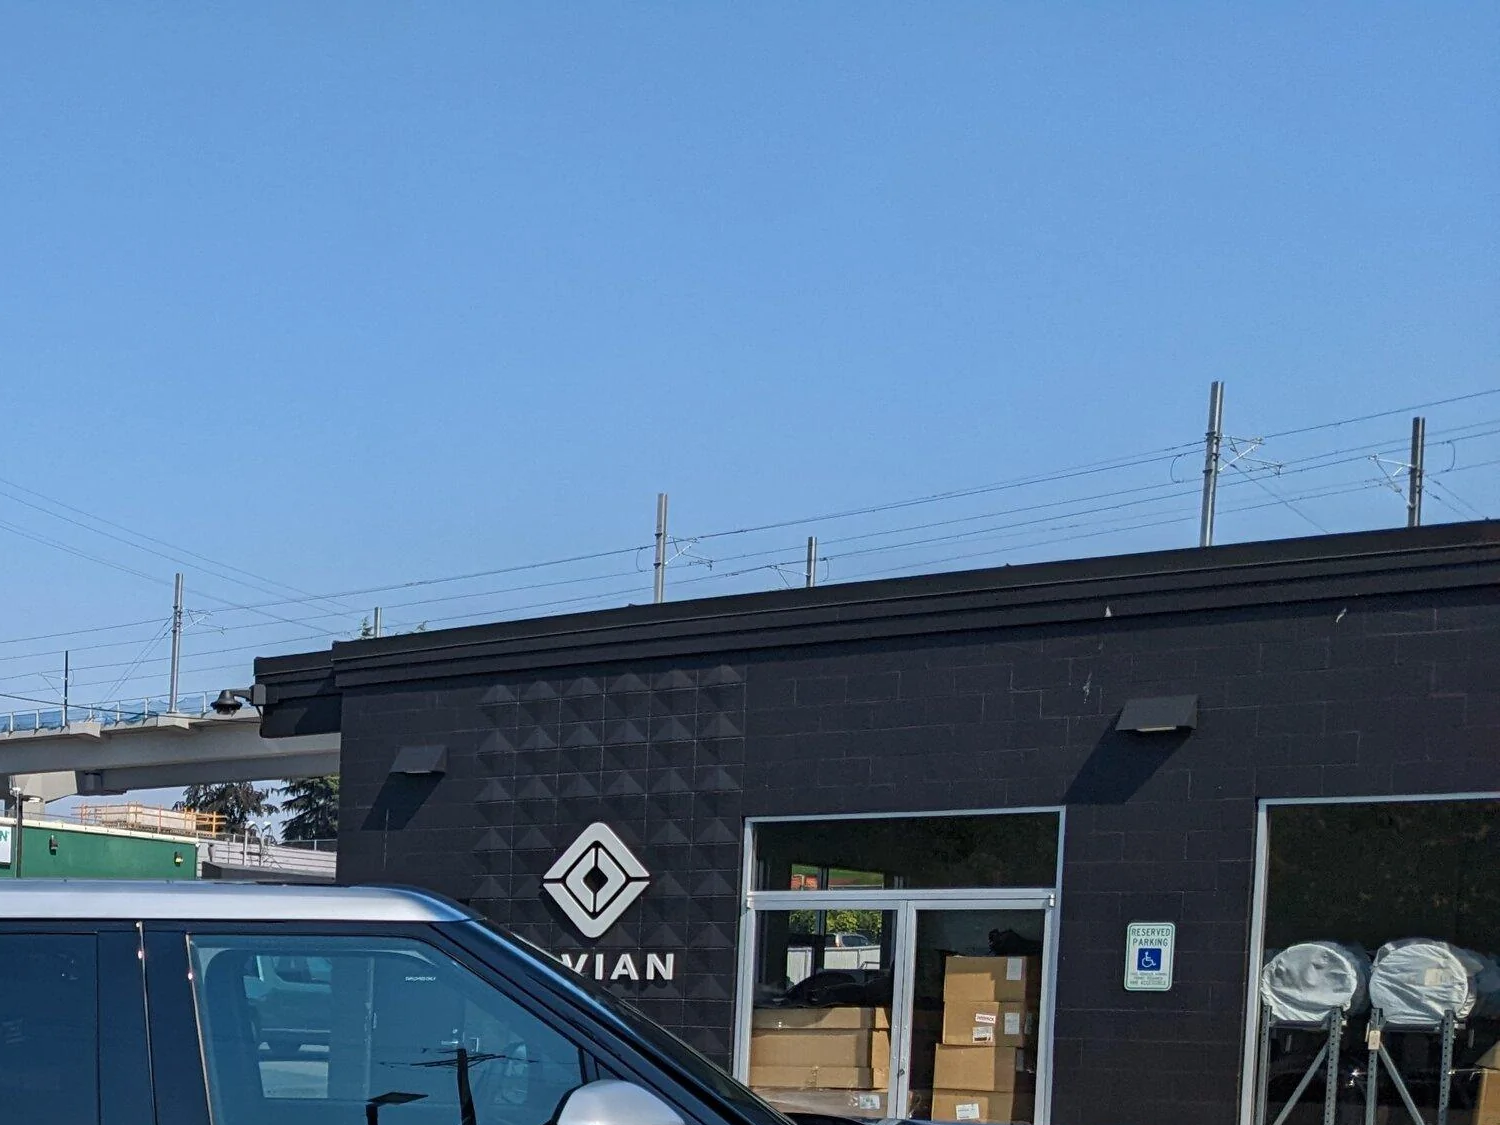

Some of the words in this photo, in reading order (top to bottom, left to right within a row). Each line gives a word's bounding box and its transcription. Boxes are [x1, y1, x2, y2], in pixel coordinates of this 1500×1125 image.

[1131, 928, 1171, 937] RESERVED
[1132, 938, 1168, 947] PARKING
[560, 953, 675, 981] VIAN
